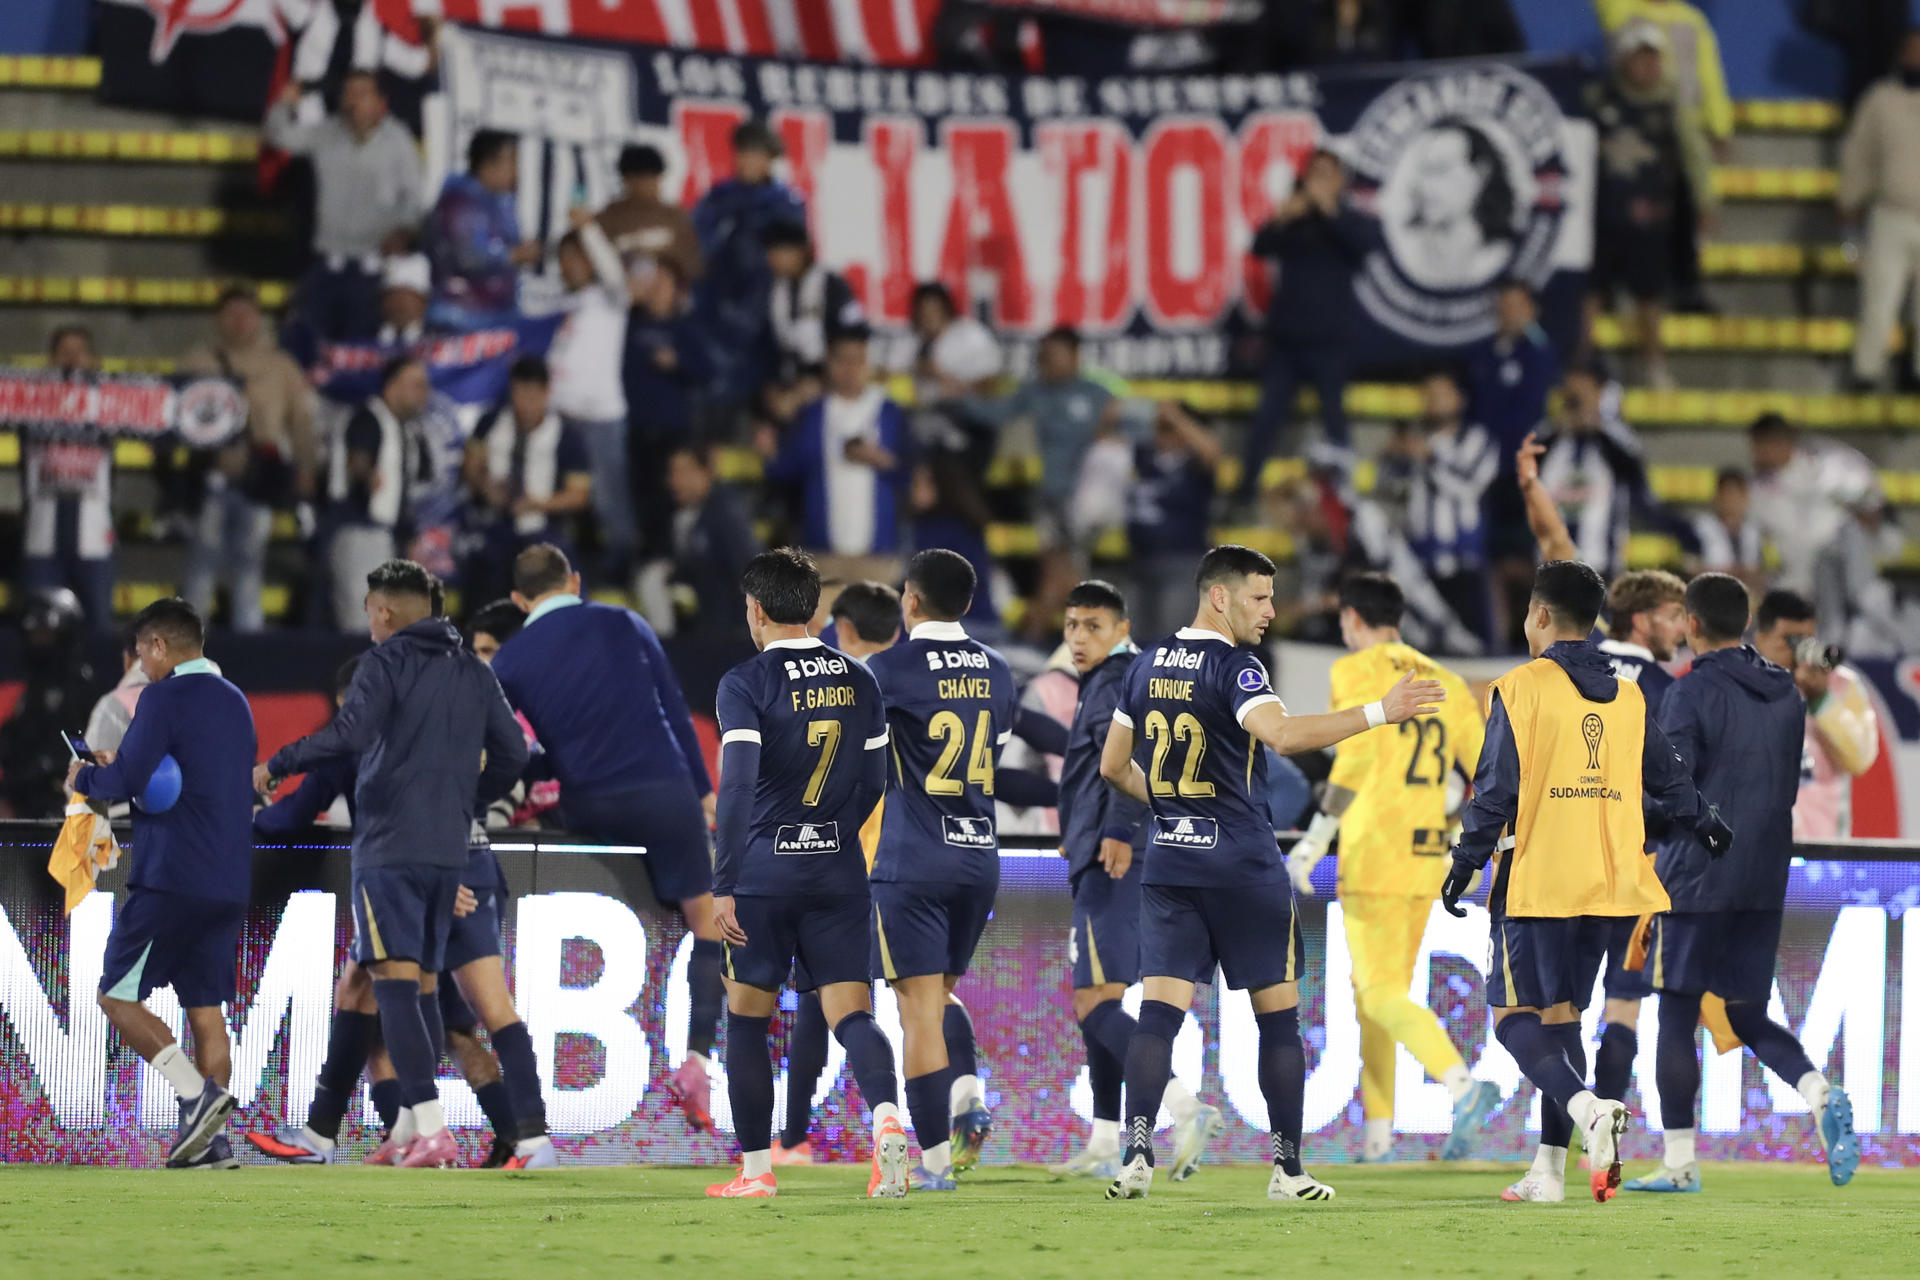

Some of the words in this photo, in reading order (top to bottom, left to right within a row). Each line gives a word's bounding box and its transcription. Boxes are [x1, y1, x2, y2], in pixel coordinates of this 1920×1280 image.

[1021, 75, 1086, 118] DE
[800, 656, 849, 678] bitel
[943, 650, 990, 669] bitel
[1164, 647, 1205, 670] bitel
[791, 690, 805, 712] F.
[806, 686, 856, 709] GAIBOR
[938, 673, 991, 699] CHÁVEZ
[1149, 677, 1194, 702] ENRIQUE
[802, 719, 842, 807] 7
[925, 709, 995, 796] 24
[1145, 710, 1216, 798] 22
[1399, 716, 1446, 786] 23
[1549, 787, 1622, 802] SUDAMERICANA
[778, 840, 836, 850] ANYPSA
